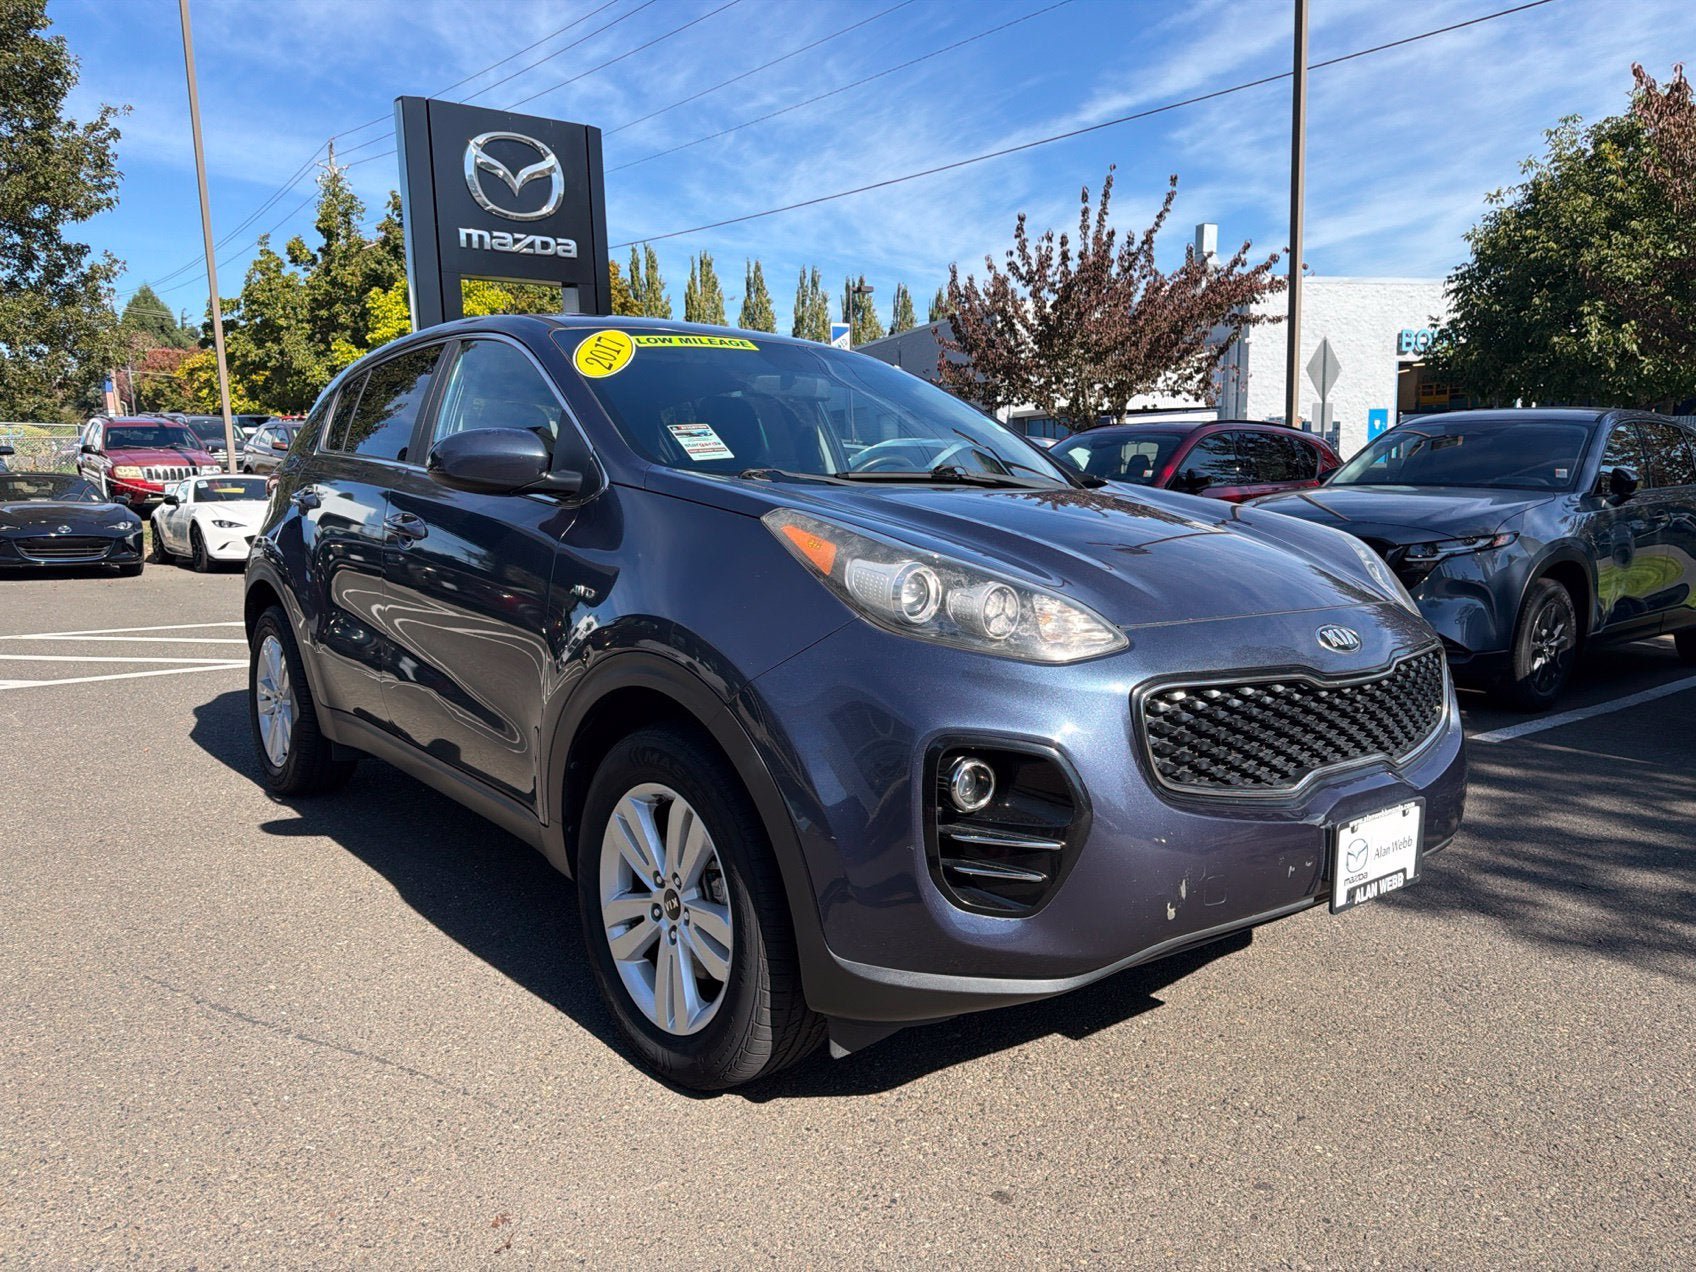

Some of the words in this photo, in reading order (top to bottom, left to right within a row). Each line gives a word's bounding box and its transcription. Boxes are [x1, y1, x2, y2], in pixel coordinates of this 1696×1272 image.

[585, 336, 625, 371] 2017
[635, 337, 673, 345] LOW
[679, 337, 751, 348] MILEAGE
[1320, 628, 1359, 648] KIA
[1374, 846, 1391, 860] Alan
[1391, 836, 1413, 853] Webb
[1354, 881, 1378, 905] ALAN
[1379, 872, 1404, 895] WEBB
